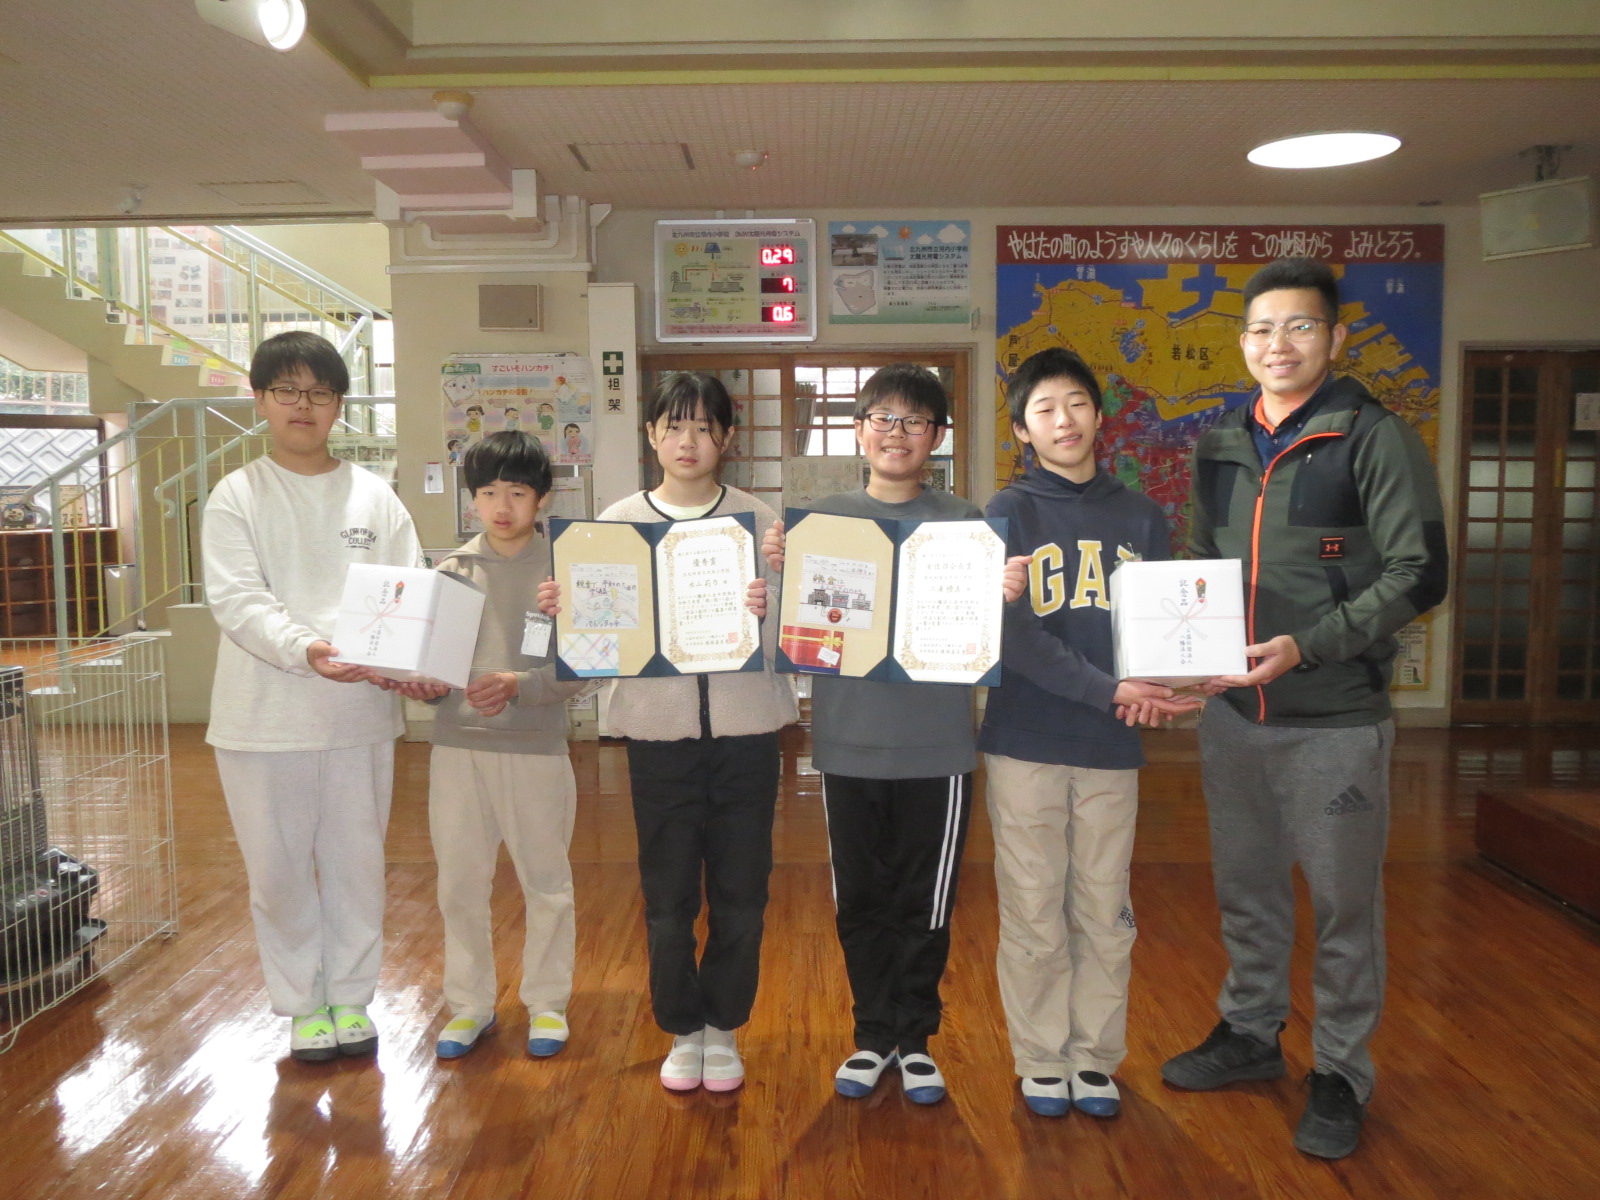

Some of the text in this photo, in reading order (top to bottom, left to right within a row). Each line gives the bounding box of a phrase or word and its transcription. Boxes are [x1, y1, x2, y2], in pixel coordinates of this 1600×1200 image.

[761, 248, 793, 264] 0.29
[1007, 231, 1422, 259] やはたの町のようすや人々のくらしを この地図から よみとろう。
[783, 277, 793, 291] 7
[773, 306, 793, 322] 0.6
[1171, 343, 1209, 361] 若松区
[607, 377, 621, 412] 担架
[379, 578, 391, 605] 記念品
[1028, 540, 1134, 617] GA
[1178, 578, 1189, 607] 記念品
